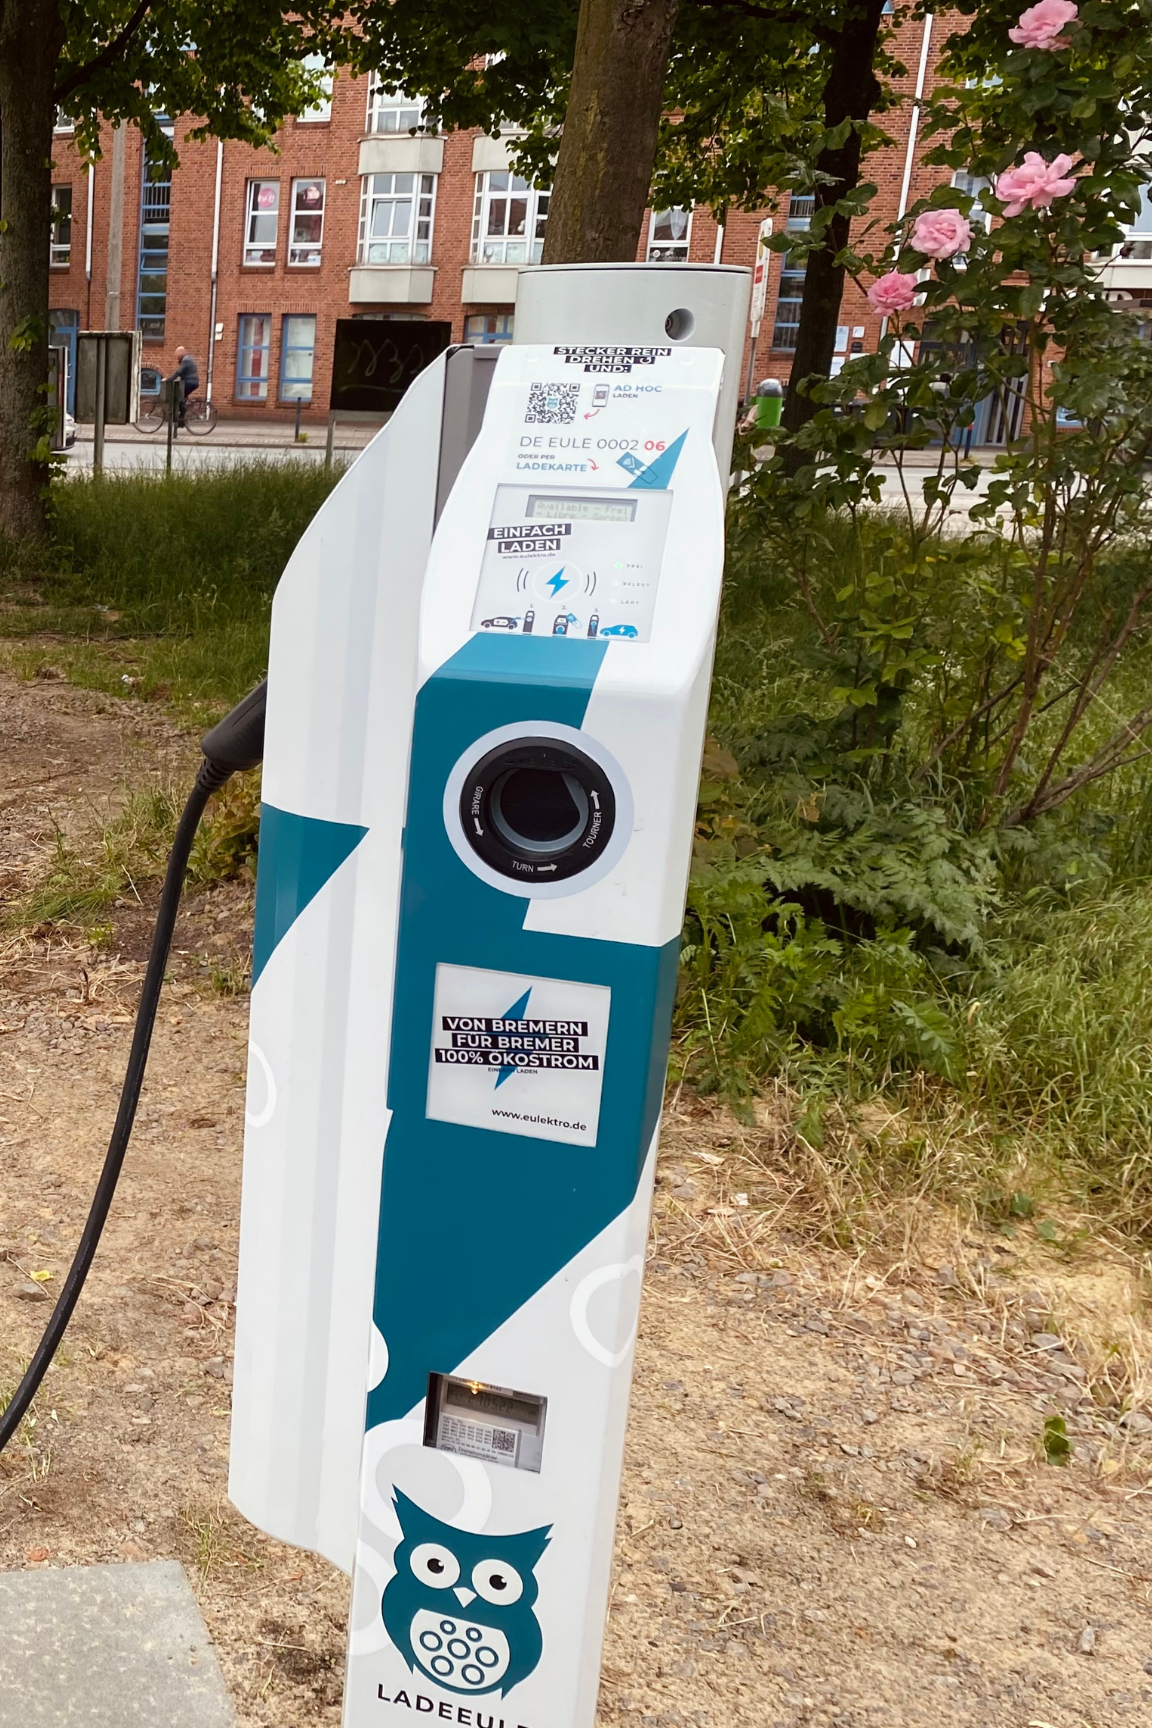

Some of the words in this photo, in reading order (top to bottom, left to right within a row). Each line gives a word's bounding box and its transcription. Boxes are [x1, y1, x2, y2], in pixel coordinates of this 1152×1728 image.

[557, 346, 630, 356] STECKER
[631, 347, 669, 356] REIN
[569, 356, 635, 364] DREHEN
[590, 364, 629, 373] UND:
[614, 384, 632, 392] AD
[635, 385, 663, 393] HOC
[520, 436, 544, 447] DE
[548, 437, 592, 449] EULE
[597, 439, 639, 450] 0002
[644, 440, 666, 451] 06
[516, 462, 587, 472] LADEKARTE
[537, 501, 589, 512] Available
[605, 505, 628, 514] Frei
[493, 524, 566, 539] EINFACH
[500, 539, 558, 553] LADEN
[471, 785, 484, 815] GIRARE
[582, 811, 602, 849] TOURNER
[512, 860, 534, 873] TURN
[446, 1017, 486, 1031] VON
[492, 1019, 582, 1035] BREMERN
[457, 1032, 493, 1048] FÜR
[498, 1035, 575, 1051] BREMER
[439, 1049, 484, 1063] 100%
[488, 1050, 594, 1069] ÖKOSTROM
[491, 1108, 587, 1131] www.eulektro.de
